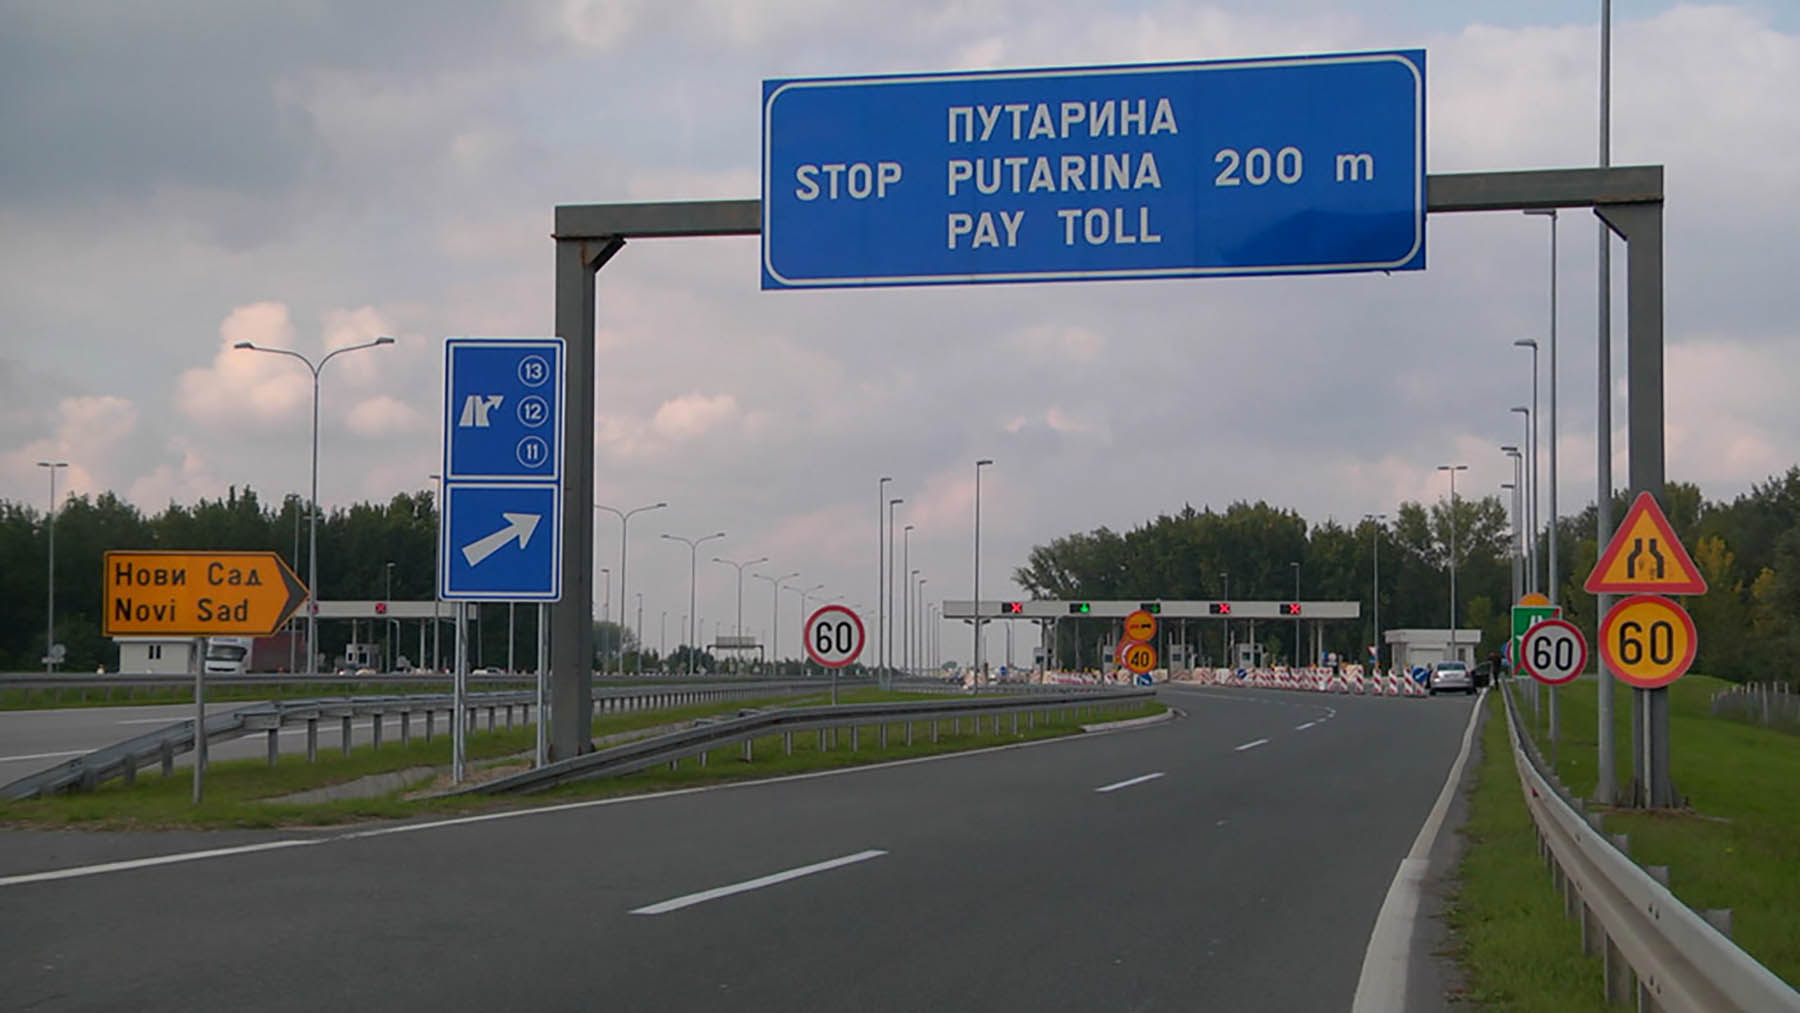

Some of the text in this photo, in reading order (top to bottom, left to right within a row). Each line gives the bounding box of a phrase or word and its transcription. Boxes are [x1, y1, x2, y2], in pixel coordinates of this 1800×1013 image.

[947, 98, 1179, 143] ПУТАРИНА
[795, 146, 1375, 201] STOP PUTARINA 200 m
[947, 206, 1162, 250] PAY TOLL
[525, 362, 543, 380] 13
[524, 402, 542, 420] 12
[526, 443, 539, 460] 11
[115, 561, 263, 586] Нови Сад
[114, 597, 249, 622] Novi Sad
[816, 621, 852, 654] 60
[1618, 620, 1674, 665] 60
[1130, 651, 1150, 668] 40
[1533, 636, 1574, 671] 60
